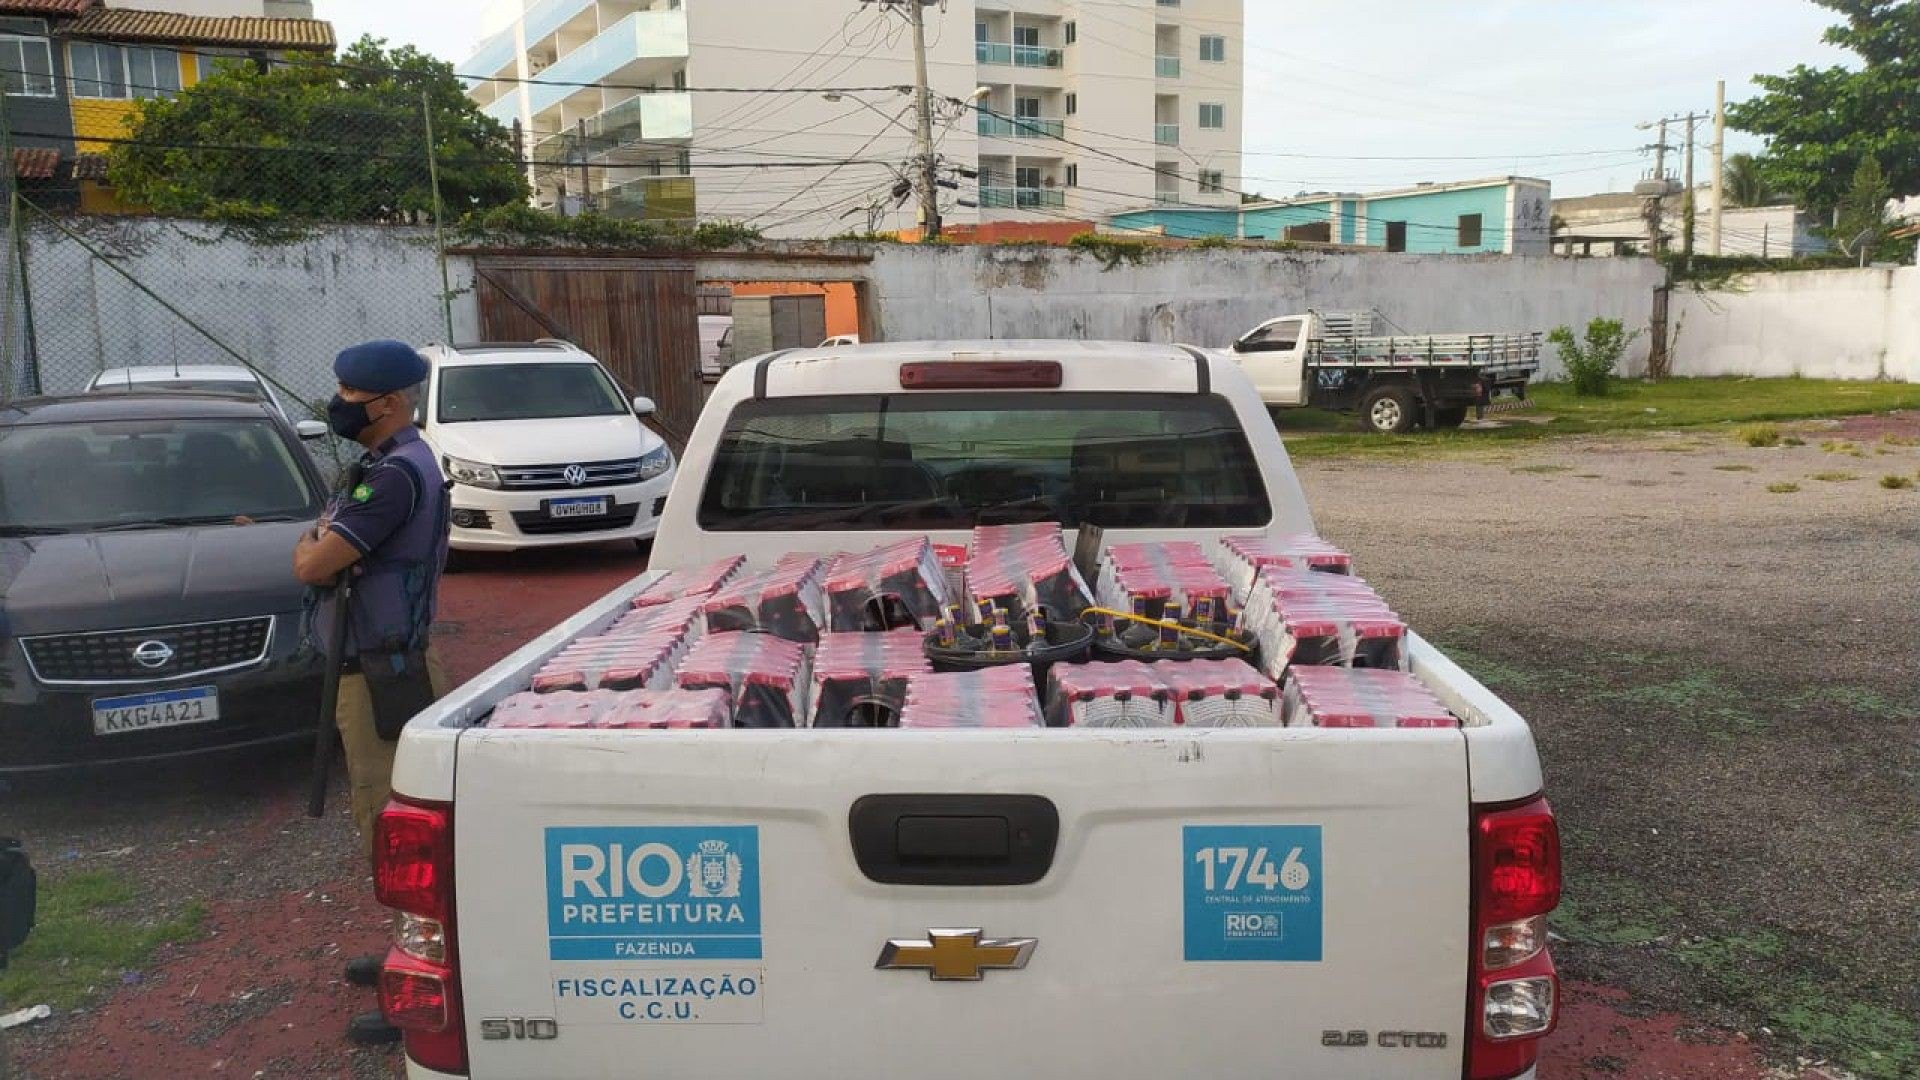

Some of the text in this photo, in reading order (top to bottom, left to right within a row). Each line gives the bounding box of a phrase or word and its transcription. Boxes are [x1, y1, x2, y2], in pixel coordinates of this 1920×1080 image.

[105, 701, 204, 730] KKG4A21
[560, 842, 683, 898] RIO
[1196, 847, 1310, 890] 1746
[563, 904, 745, 923] PREFEITURA
[1226, 914, 1262, 930] RIO
[615, 942, 696, 955] FAZENDA
[558, 973, 757, 999] FISCALIZAÇÃO
[619, 1001, 700, 1019] C.C.U.
[481, 1017, 559, 1040] S10
